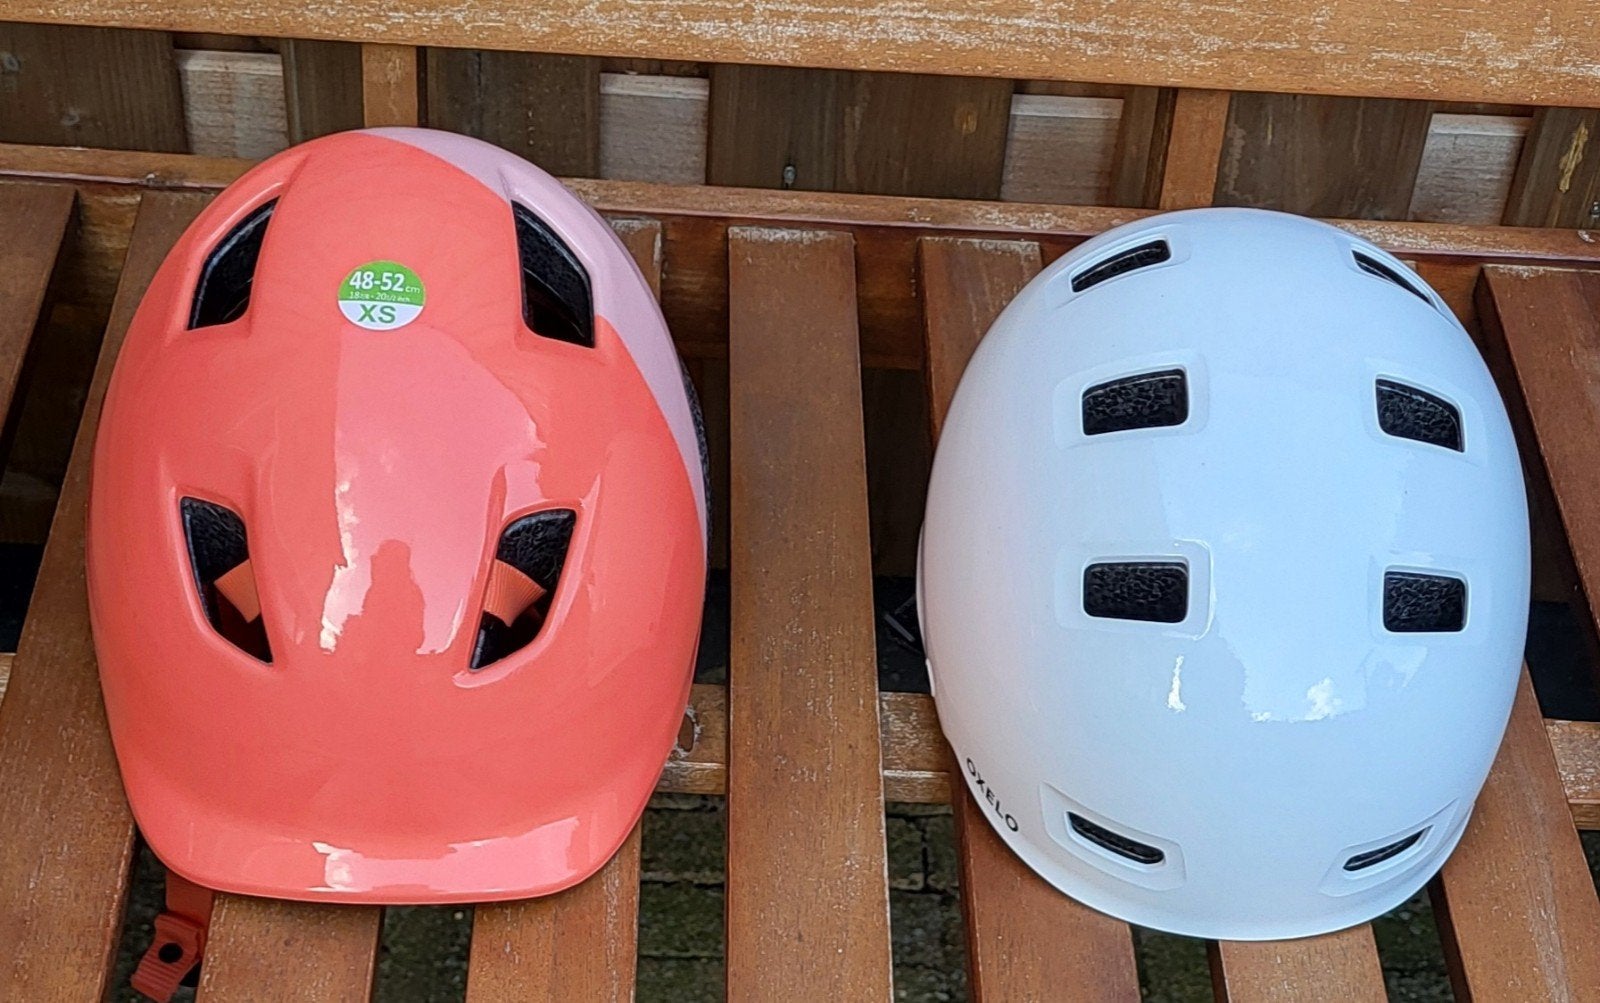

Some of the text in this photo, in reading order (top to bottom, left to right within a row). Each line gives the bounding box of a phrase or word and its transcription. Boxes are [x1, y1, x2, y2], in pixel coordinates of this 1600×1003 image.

[349, 270, 420, 294] 48-52 cm
[358, 304, 396, 323] XS
[966, 757, 1019, 832] OXELO
